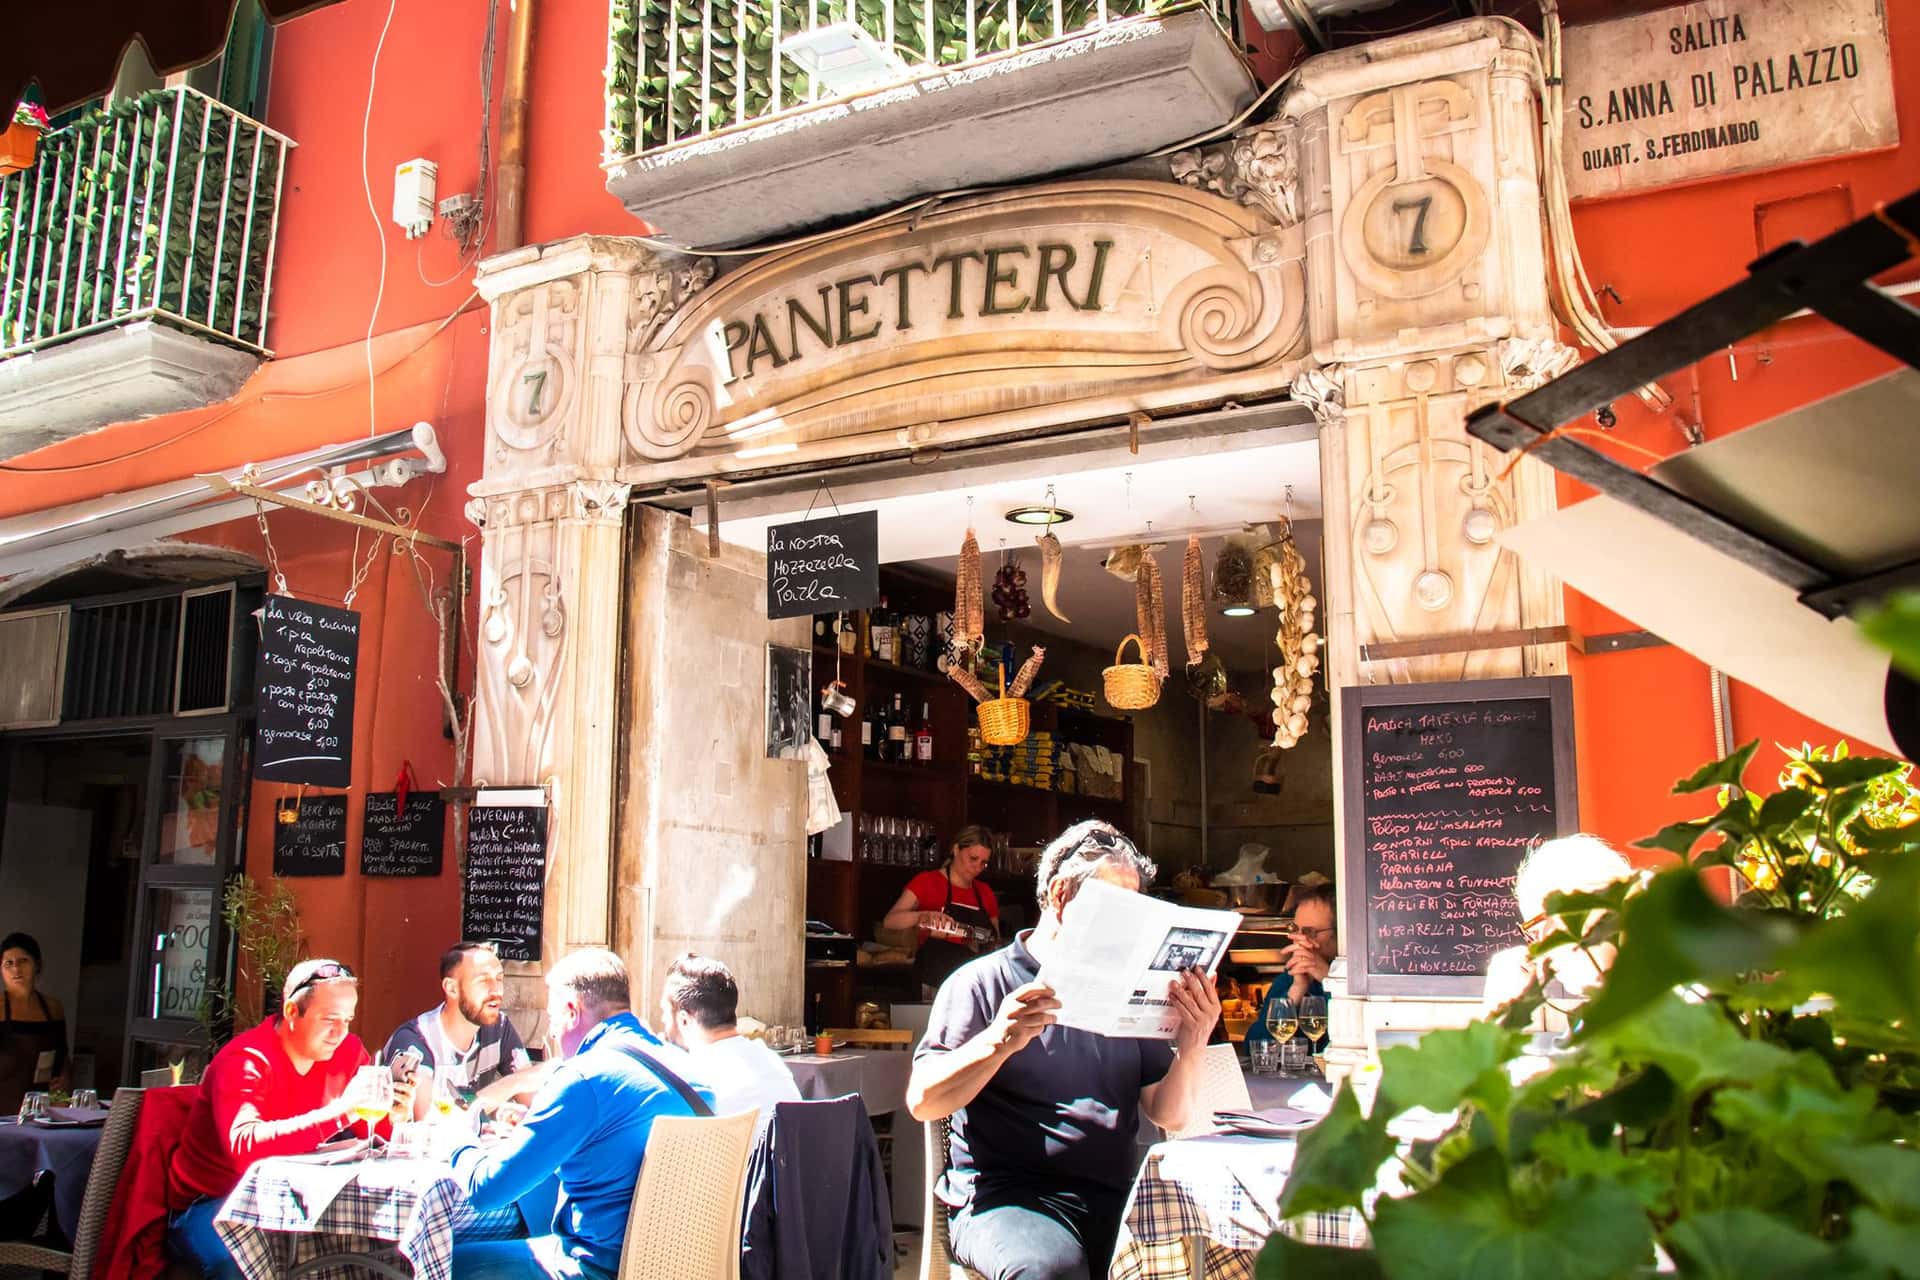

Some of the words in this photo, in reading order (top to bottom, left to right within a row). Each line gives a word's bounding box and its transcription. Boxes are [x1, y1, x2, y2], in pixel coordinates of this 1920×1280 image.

[1669, 14, 1747, 55] SALITA
[1578, 79, 1675, 130] S.ANNA
[1691, 71, 1716, 109] DI
[1732, 43, 1859, 101] PALAZZO
[1582, 142, 1640, 172] QUART.
[1646, 119, 1760, 161] S.FERDINANDO
[1391, 195, 1433, 255] 7
[522, 370, 548, 416] 7
[766, 528, 785, 553] La
